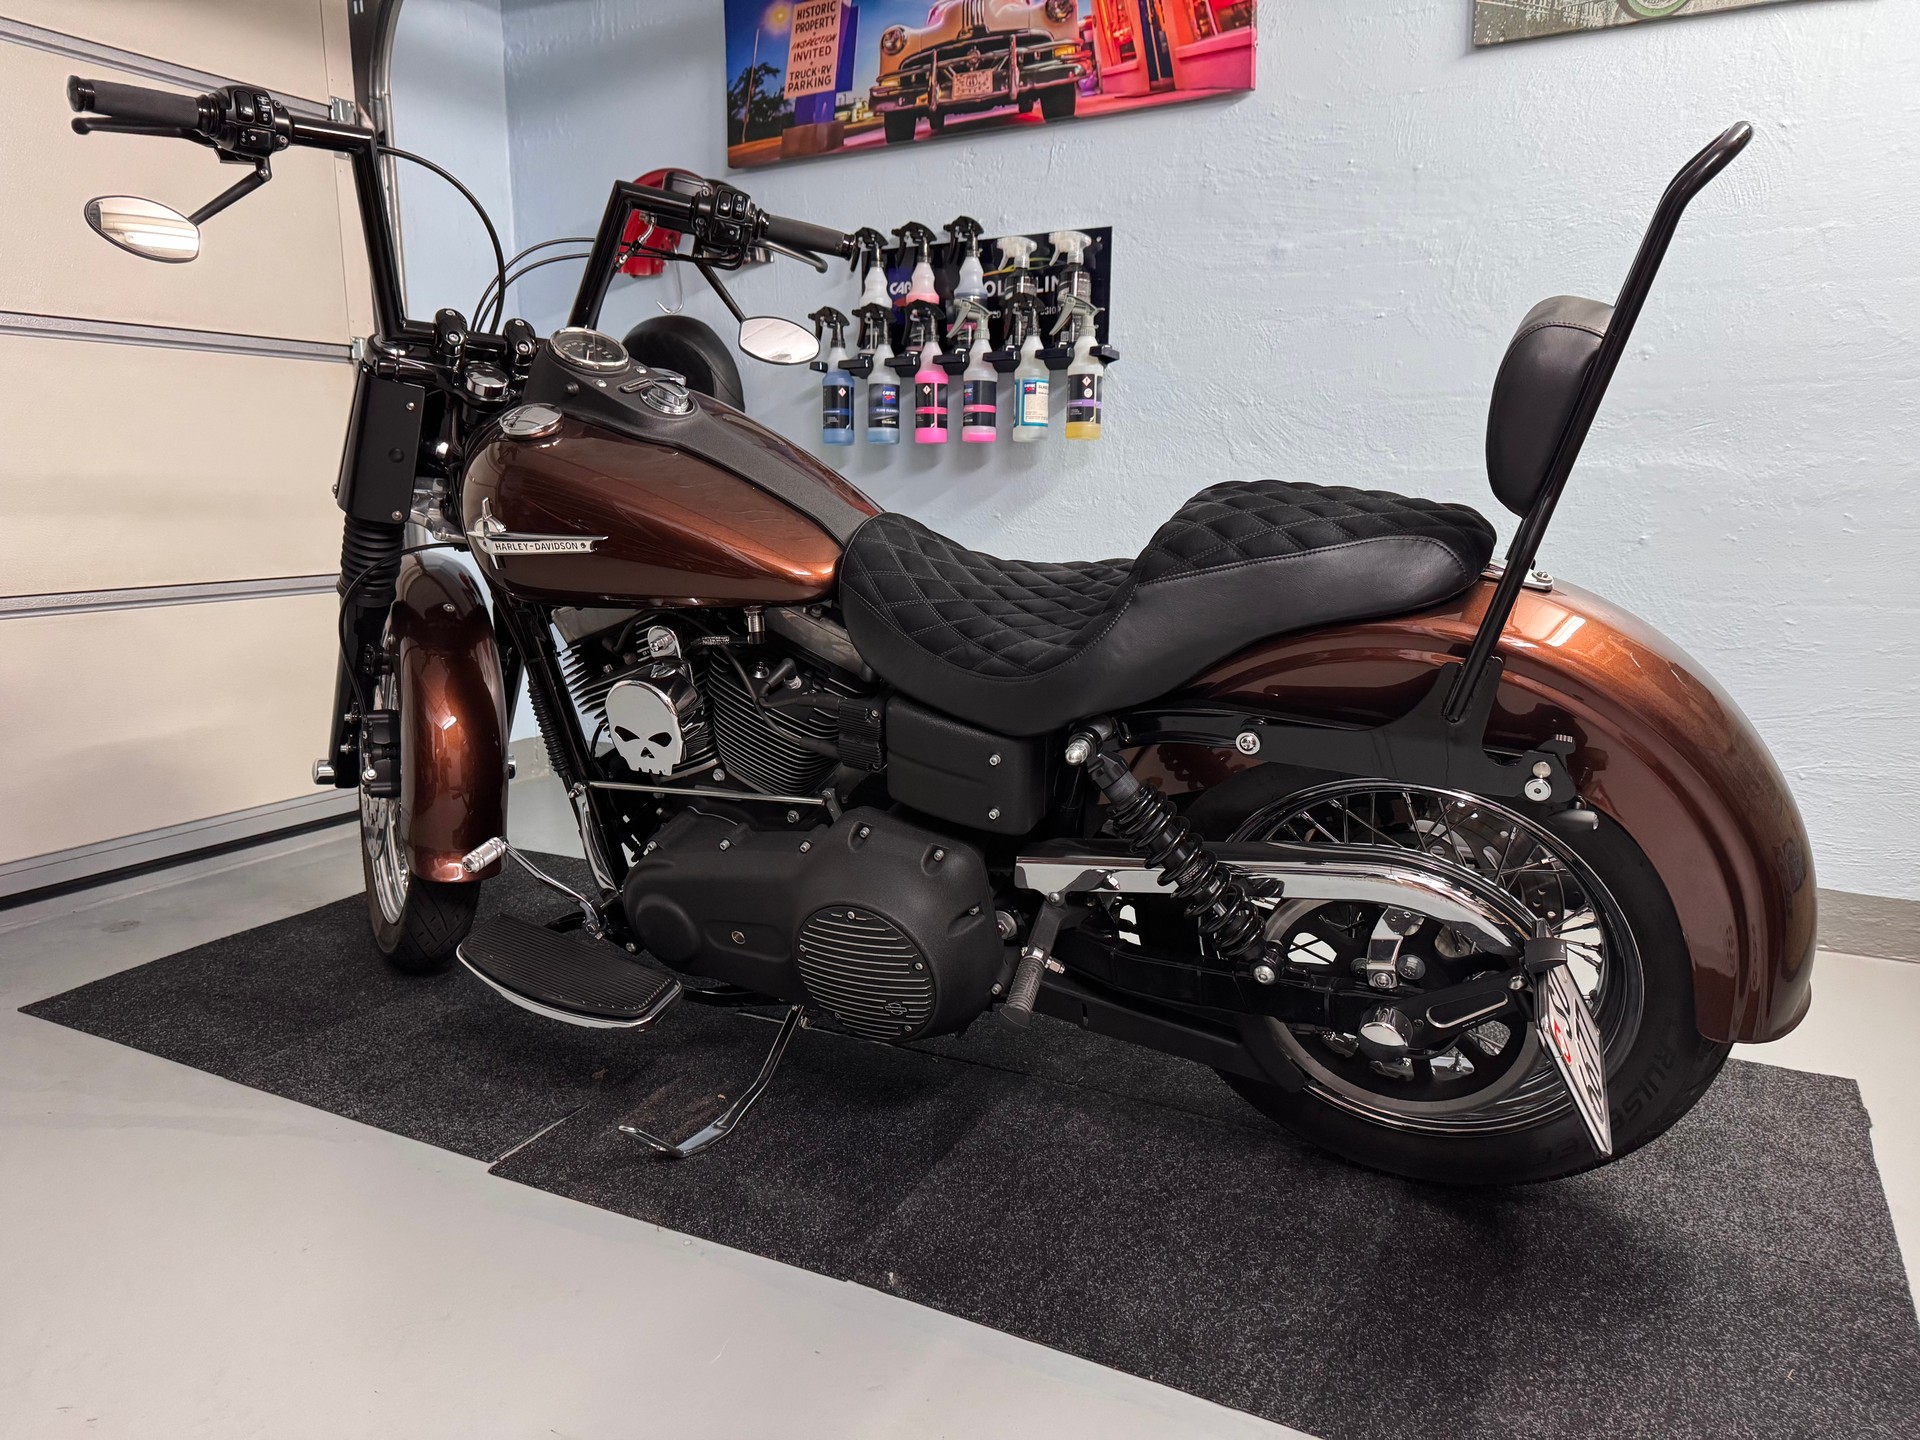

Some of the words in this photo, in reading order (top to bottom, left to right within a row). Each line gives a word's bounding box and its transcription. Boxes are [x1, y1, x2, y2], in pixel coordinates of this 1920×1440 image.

[796, 1, 836, 20] HISTORIC
[795, 14, 836, 34] PROPERTY
[791, 33, 837, 50] INSPECTION
[793, 45, 832, 62] INVITED
[788, 75, 832, 93] PARKING
[889, 281, 912, 295] CAR
[495, 541, 578, 551] HARLEY-DAVIDSON
